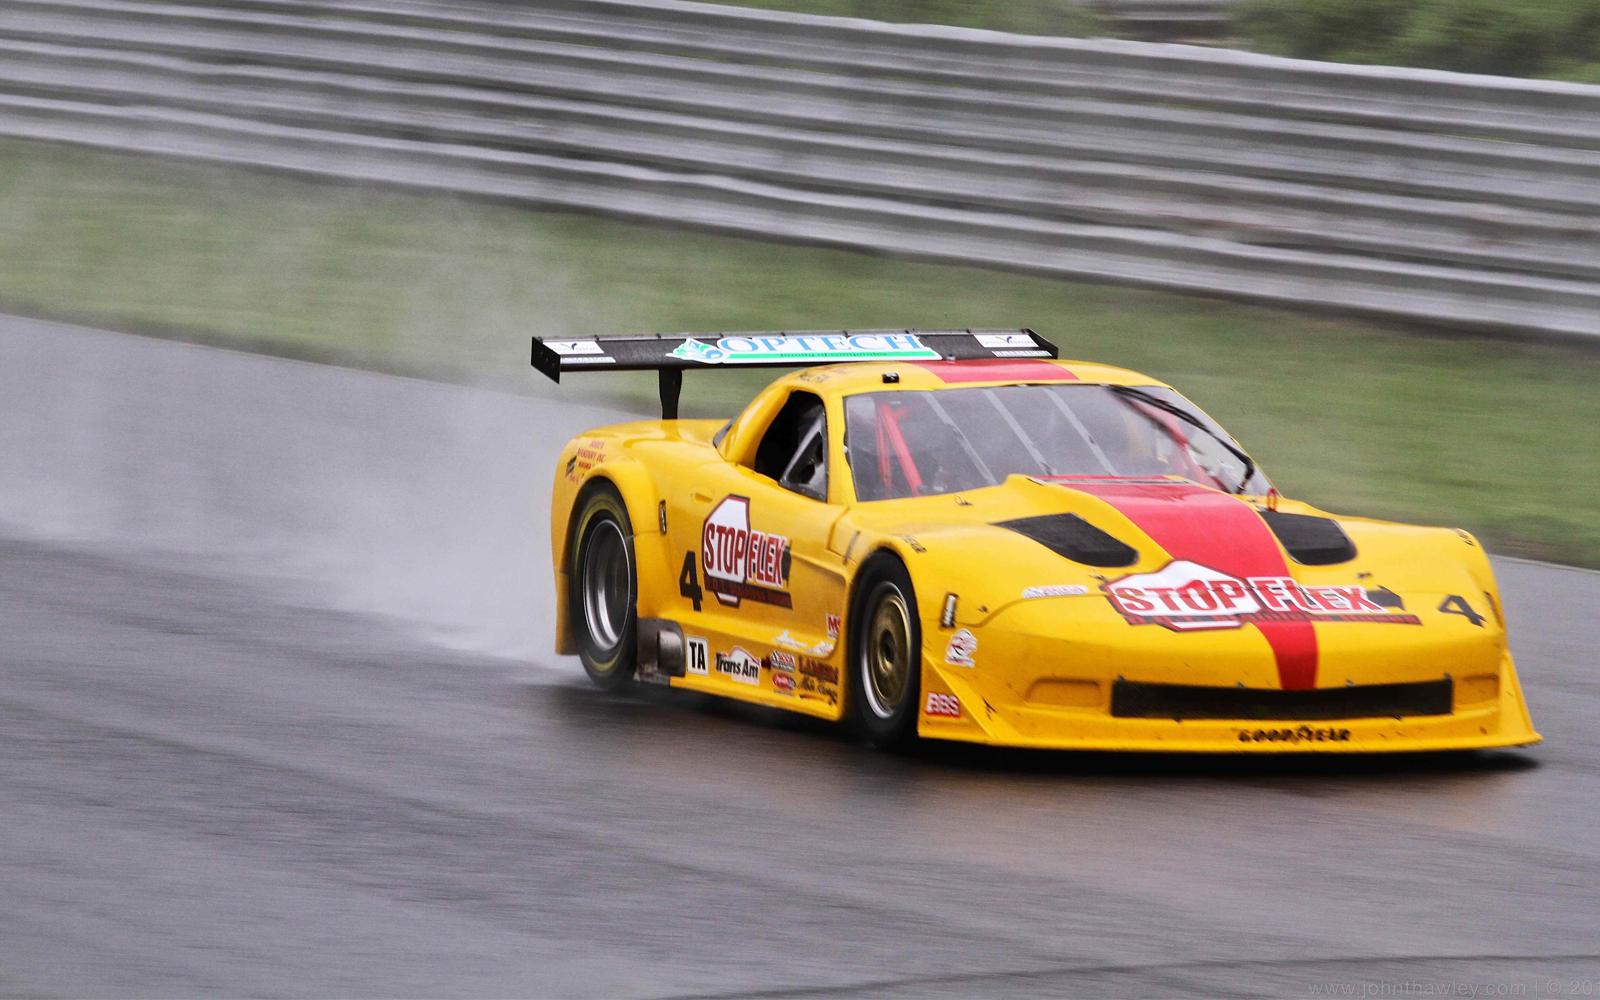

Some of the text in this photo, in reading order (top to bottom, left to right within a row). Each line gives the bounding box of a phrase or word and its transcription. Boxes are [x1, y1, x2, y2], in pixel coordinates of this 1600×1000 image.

[719, 335, 923, 352] OPTECH
[704, 522, 785, 586] STOP FLEX
[679, 550, 703, 612] 4
[1112, 578, 1387, 613] STOP FLEX
[1438, 594, 1490, 628] 4
[689, 641, 706, 670] TA
[716, 652, 741, 676] Trans
[742, 658, 759, 680] Am
[1237, 725, 1352, 745] GOODYEAR
